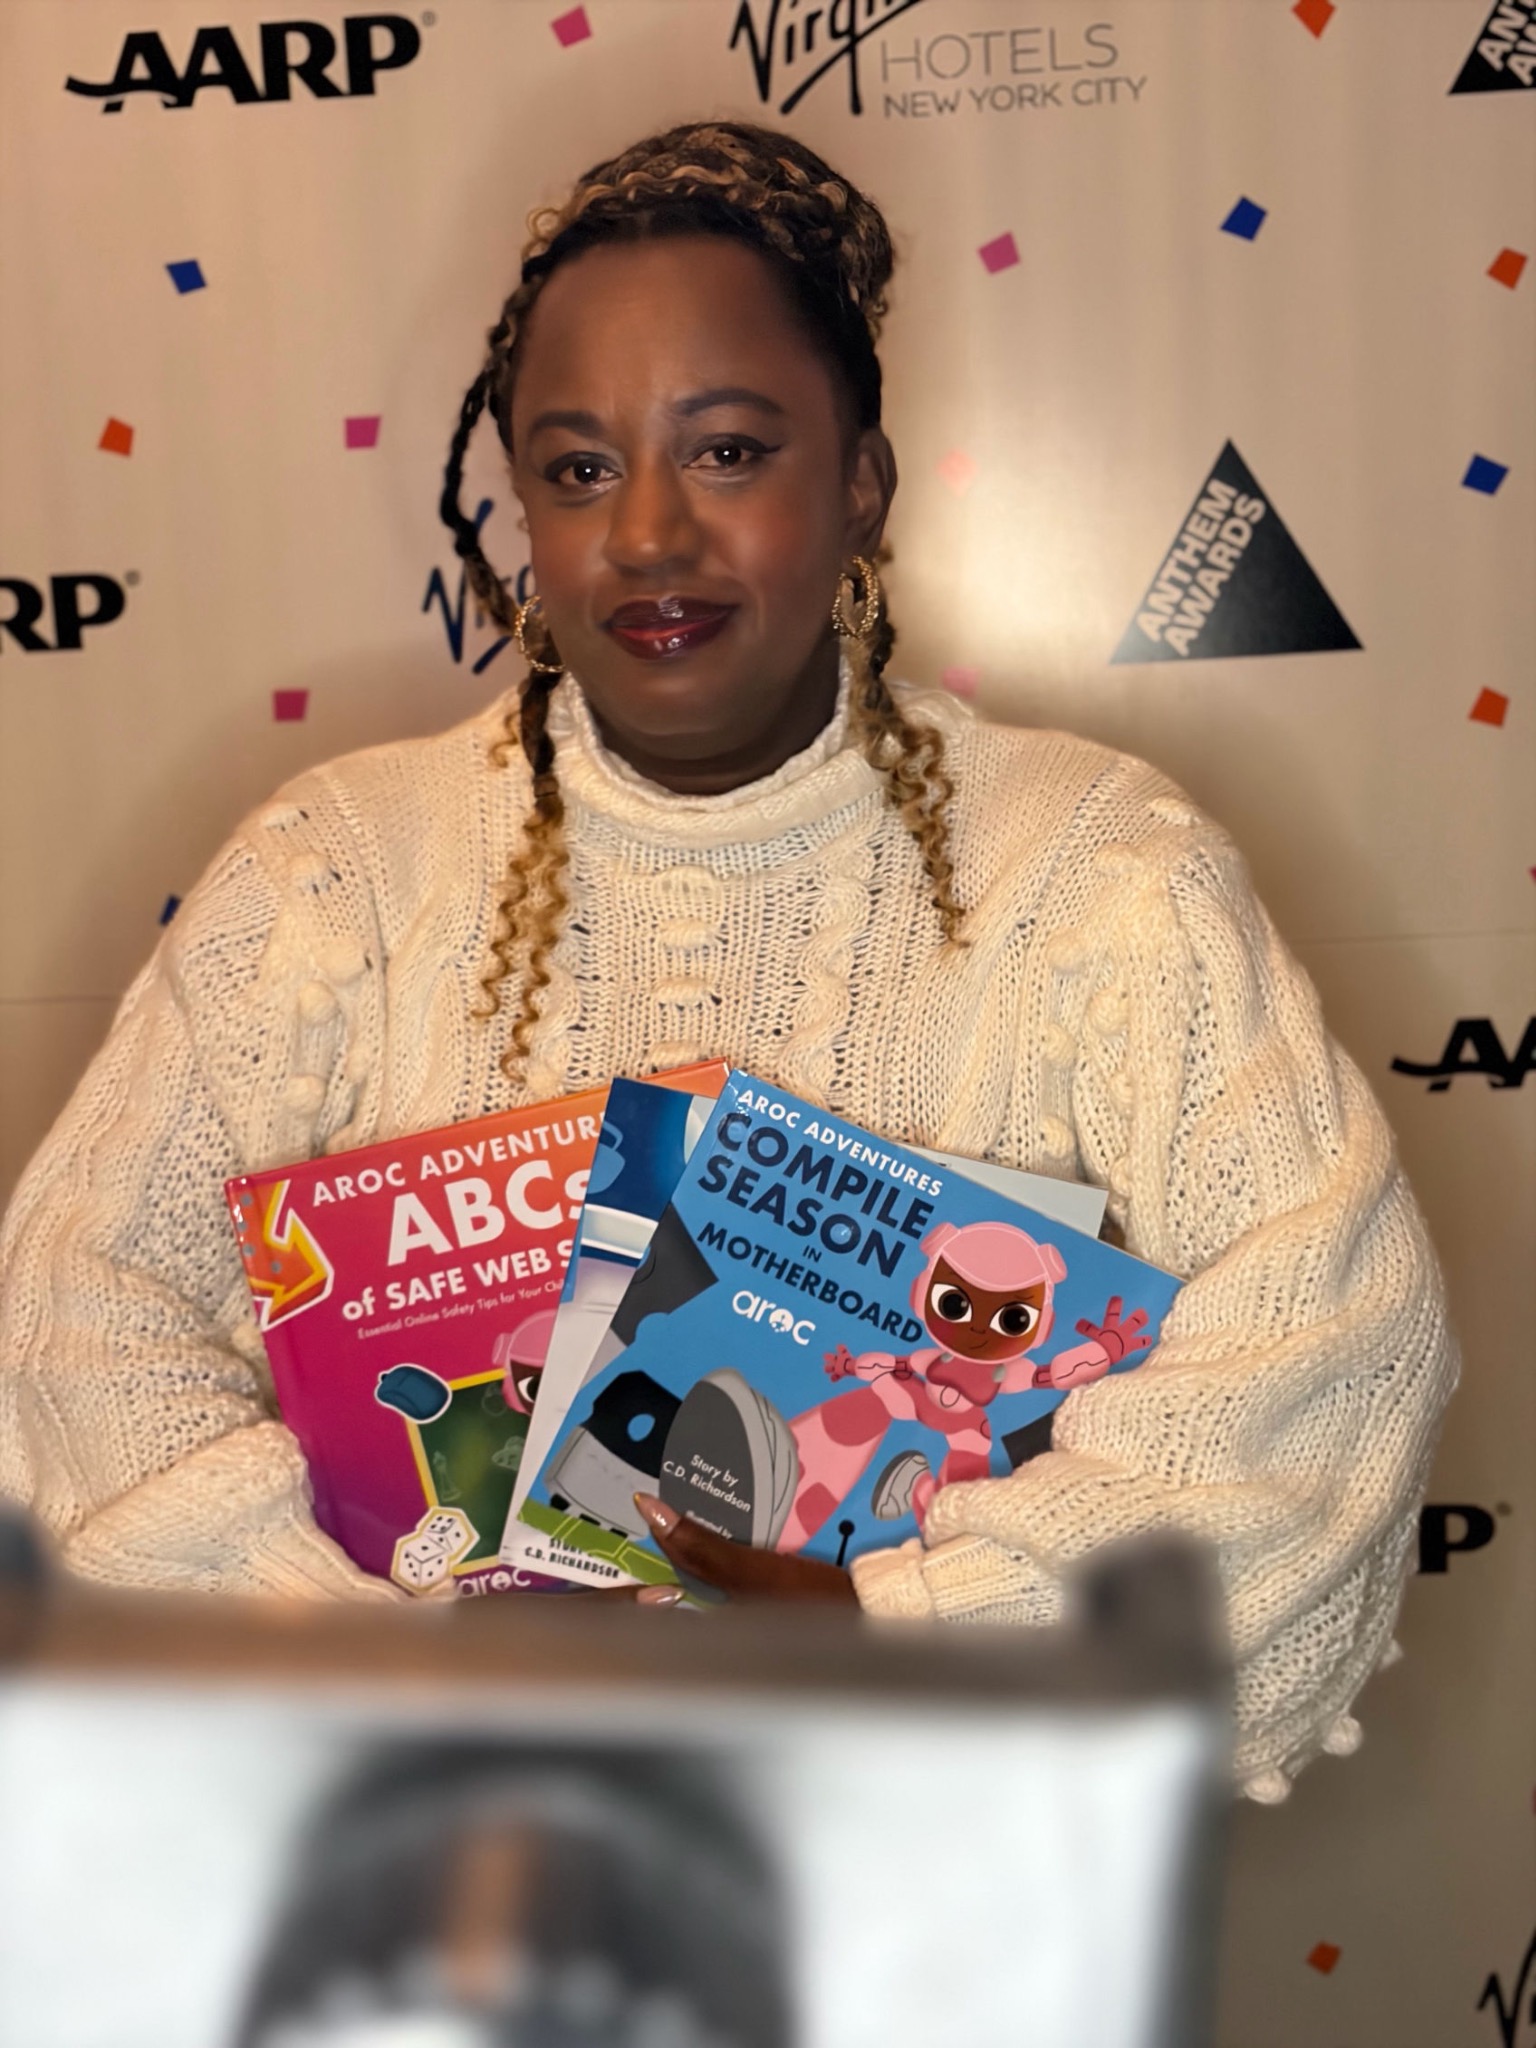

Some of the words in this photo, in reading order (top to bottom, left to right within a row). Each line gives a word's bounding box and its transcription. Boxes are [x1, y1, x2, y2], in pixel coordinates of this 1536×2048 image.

[729, 0, 925, 115] Virg
[881, 23, 1119, 82] HOTELS
[884, 89, 961, 119] NEW
[968, 80, 1062, 113] YORK
[1071, 75, 1147, 106] CITY
[1136, 479, 1238, 642] ANTHEM
[1164, 494, 1267, 656] AWARDS
[313, 1161, 405, 1207] AROC
[420, 1111, 605, 1181] ADVENTUR
[716, 1112, 935, 1240] COMPILE
[737, 1089, 801, 1128] AROC
[803, 1121, 943, 1196] ADVENTURES
[697, 1154, 906, 1278] SEASON
[803, 1244, 822, 1263] IN
[342, 1287, 375, 1321] of
[386, 1267, 467, 1310] SAFE
[473, 1248, 552, 1287] WEB
[358, 1319, 402, 1340] Essential
[405, 1312, 440, 1328] Online
[442, 1302, 475, 1318] Safety
[477, 1297, 499, 1312] Tips
[500, 1292, 515, 1304] for
[518, 1286, 541, 1299] Your
[697, 1221, 923, 1343] MOTHERBOARD
[663, 1460, 686, 1481] C.D.
[690, 1473, 751, 1512] Richardson
[690, 1454, 722, 1478] Story
[723, 1470, 739, 1487] by
[549, 1552, 620, 1579] RICHARDSON
